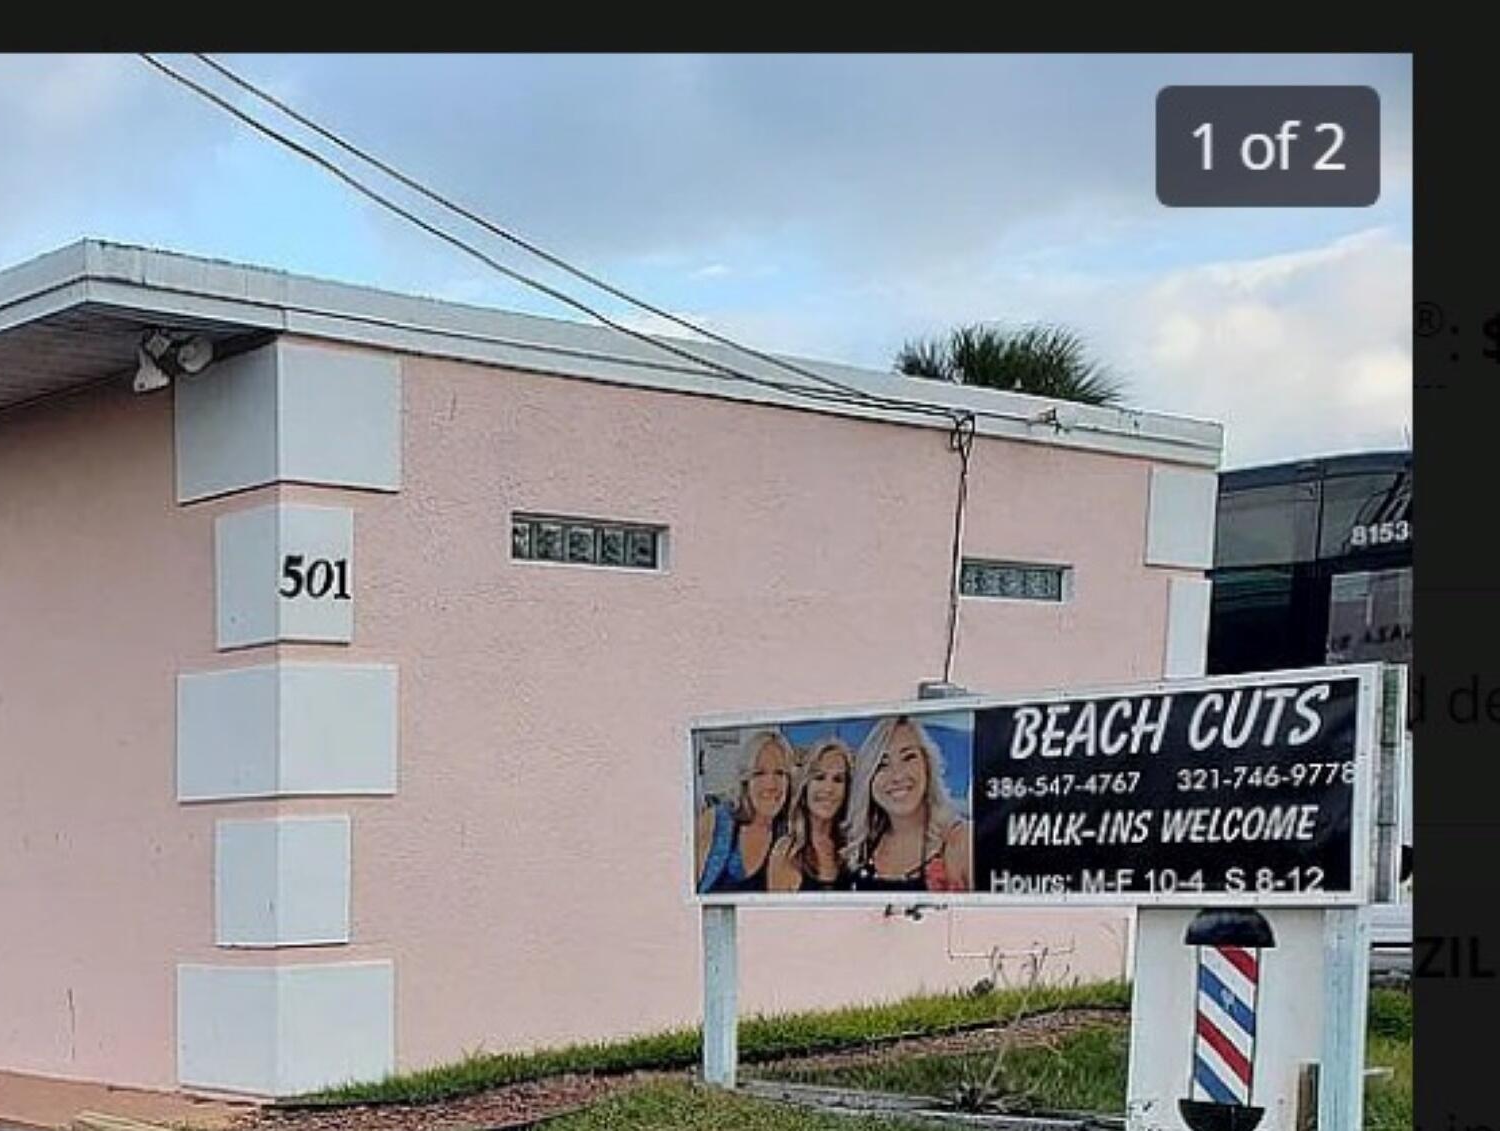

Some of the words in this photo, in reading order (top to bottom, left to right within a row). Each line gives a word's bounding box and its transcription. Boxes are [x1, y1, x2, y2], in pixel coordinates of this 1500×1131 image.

[278, 554, 351, 600] 501
[1009, 696, 1172, 760] BEACH
[1188, 684, 1329, 751] CUTS
[985, 771, 1141, 799] 386-547-4767
[1006, 809, 1152, 846] WALK-INS
[1160, 804, 1319, 844] WELCOME
[989, 870, 1073, 893] Hours:
[1080, 868, 1135, 893] M-F
[1143, 868, 1204, 892] 10-4
[1224, 867, 1247, 893] S
[1255, 866, 1326, 893] 8-12
